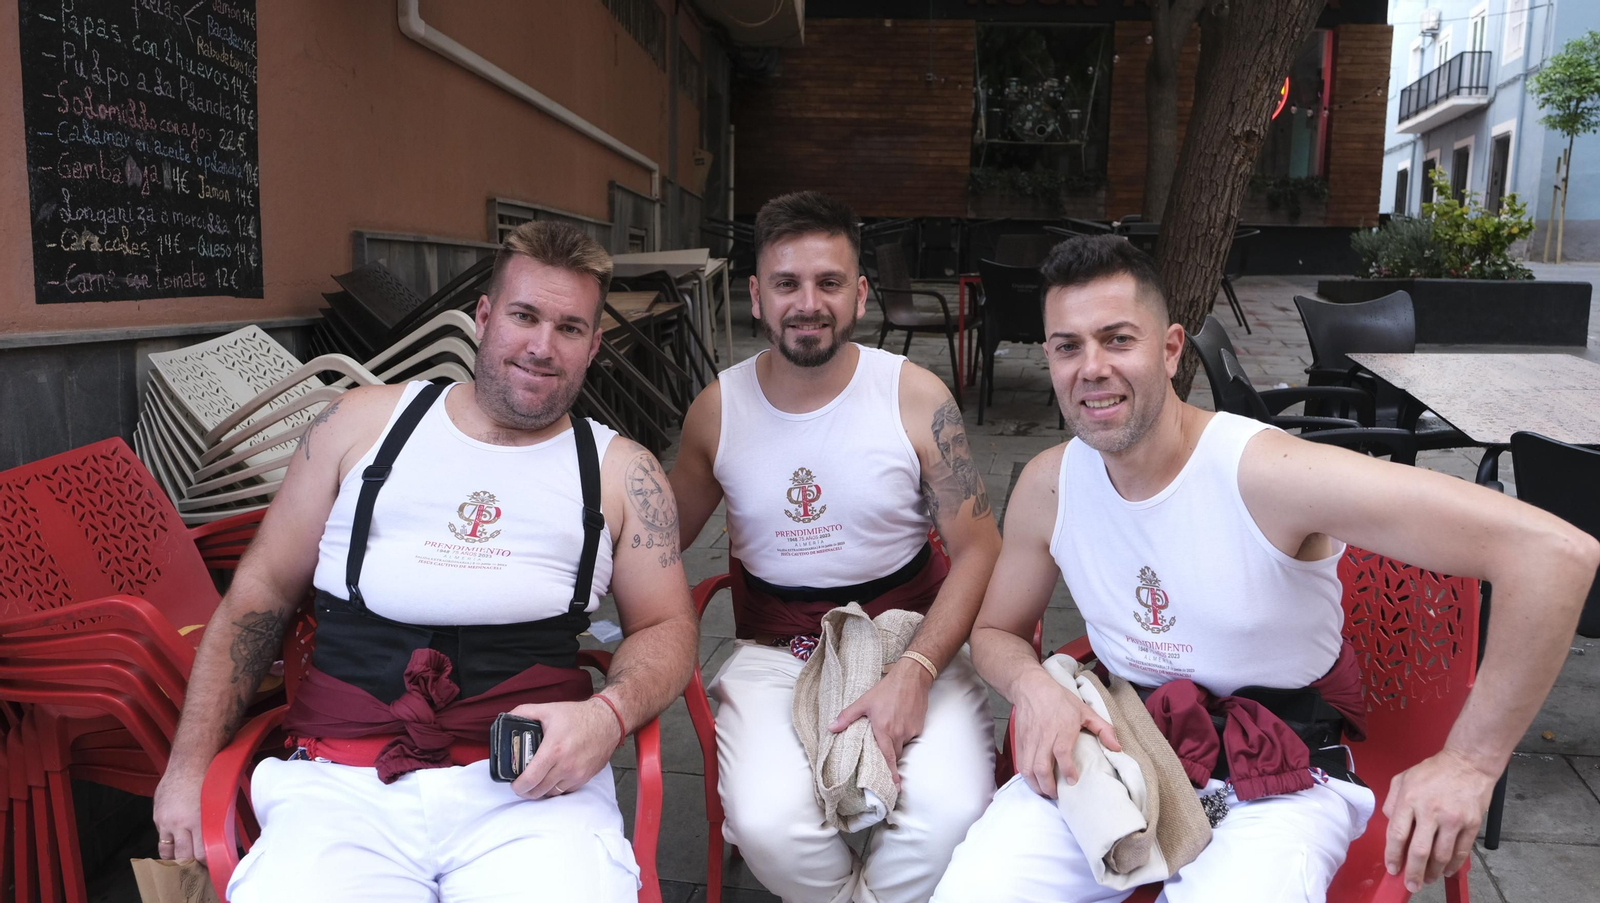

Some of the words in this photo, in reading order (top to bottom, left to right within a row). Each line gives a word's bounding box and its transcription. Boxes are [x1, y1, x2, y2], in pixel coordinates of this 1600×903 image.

[61, 0, 122, 51] Papas
[132, 34, 160, 61] con
[164, 38, 173, 64] 2
[175, 41, 230, 91] huevos
[231, 75, 251, 104] 14€
[62, 40, 130, 101] Pulpo
[136, 72, 152, 93] a
[153, 66, 175, 99] la
[233, 104, 255, 131] 18€
[57, 79, 158, 131] Solomillo
[219, 128, 248, 157] 22€
[57, 118, 131, 149] Calamar
[154, 139, 192, 164] aceite
[57, 149, 124, 184] Gamba
[235, 186, 255, 207] 14€
[157, 232, 181, 256] 14€
[155, 253, 207, 291] tomate
[215, 267, 239, 290] 12€
[775, 524, 843, 537] PRENDIMIENTO
[424, 540, 511, 557] PRENDIMIENTO
[1125, 635, 1193, 653] PRENDIMIENTO
